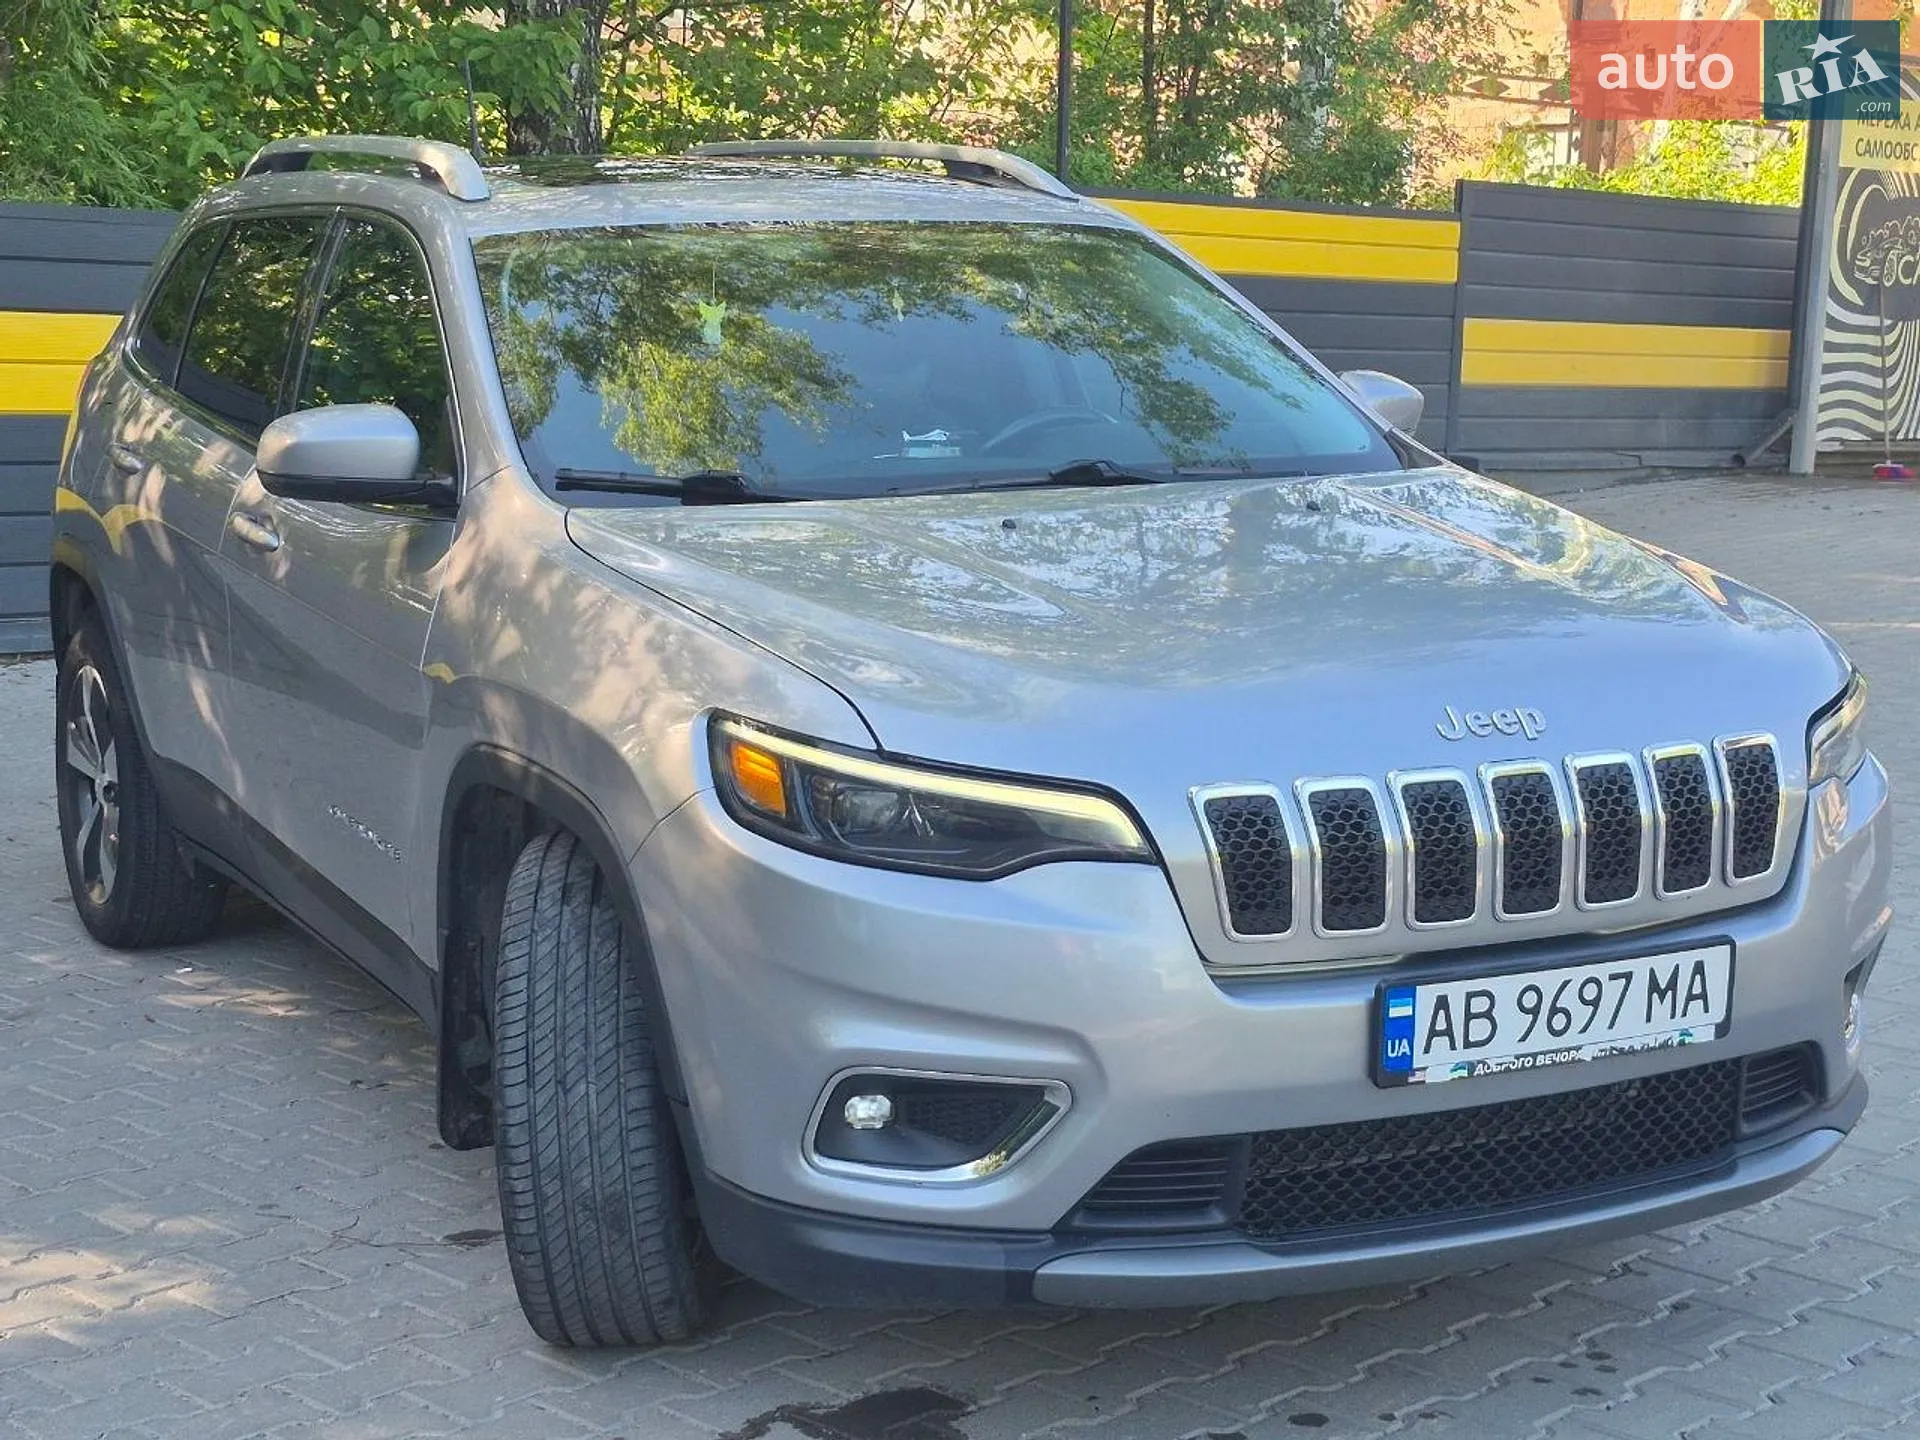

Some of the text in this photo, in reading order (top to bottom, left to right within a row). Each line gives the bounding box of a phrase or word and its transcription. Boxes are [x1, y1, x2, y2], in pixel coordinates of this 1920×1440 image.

[1436, 704, 1547, 741] Jeep
[1423, 960, 1710, 1054] AB 9697 MA
[1387, 1038, 1411, 1057] UA
